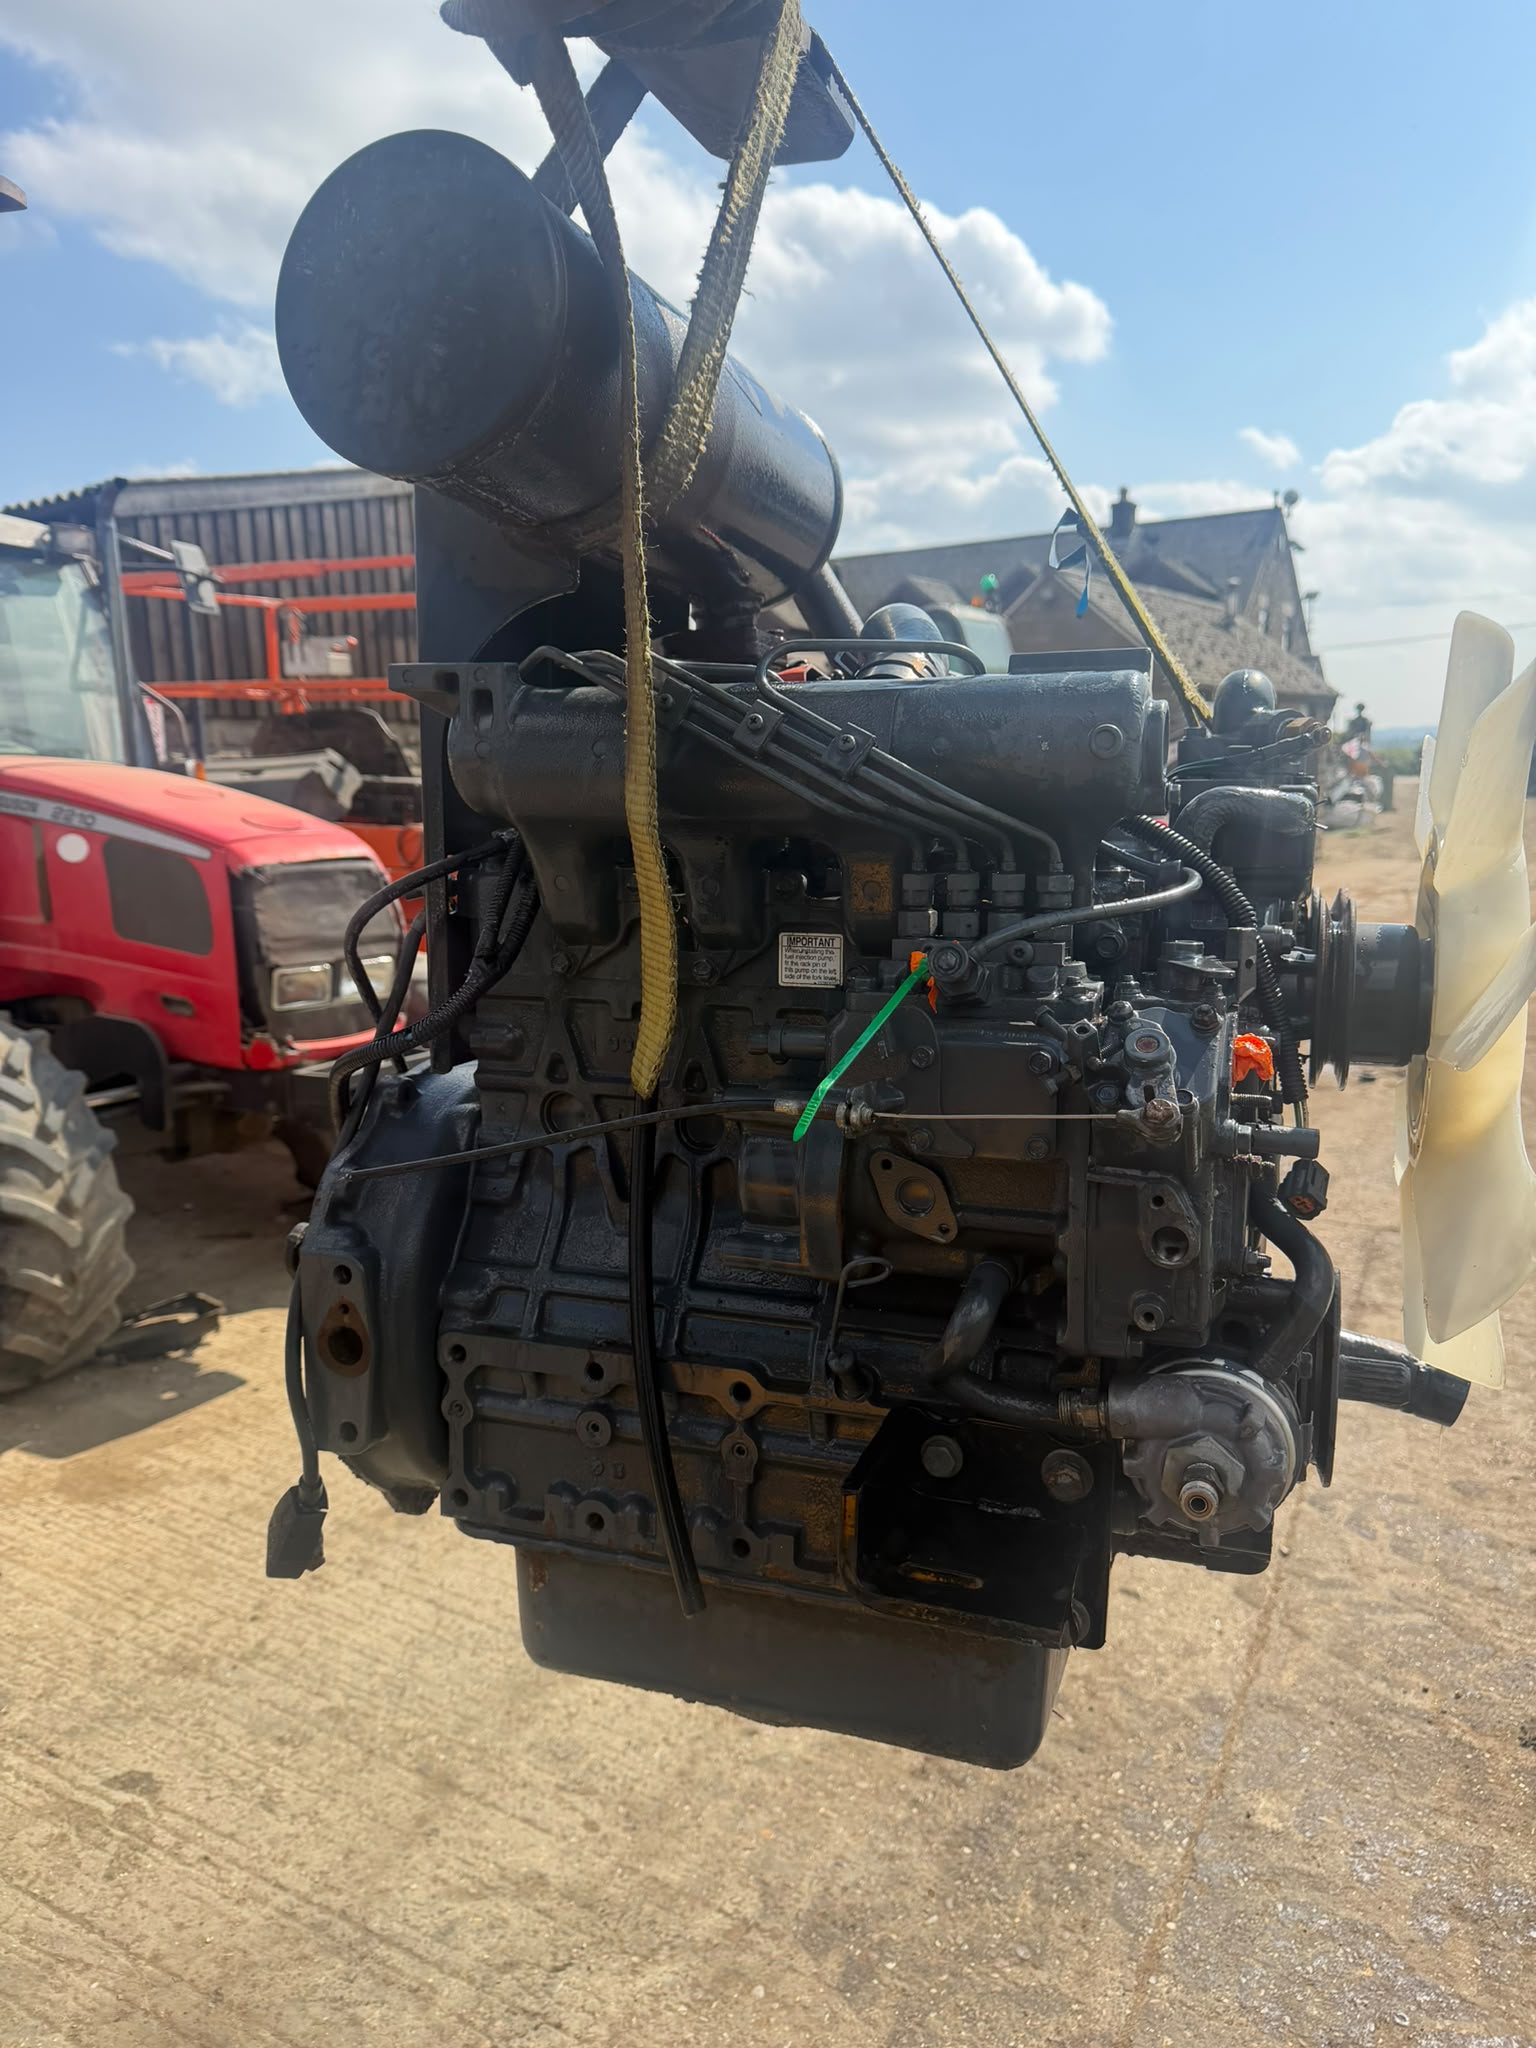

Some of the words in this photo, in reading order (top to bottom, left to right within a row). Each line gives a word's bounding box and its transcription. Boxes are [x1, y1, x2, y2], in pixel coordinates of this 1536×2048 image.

[50, 805, 96, 826] 2210
[786, 937, 835, 947] IMPORTANT
[795, 954, 817, 962] injection
